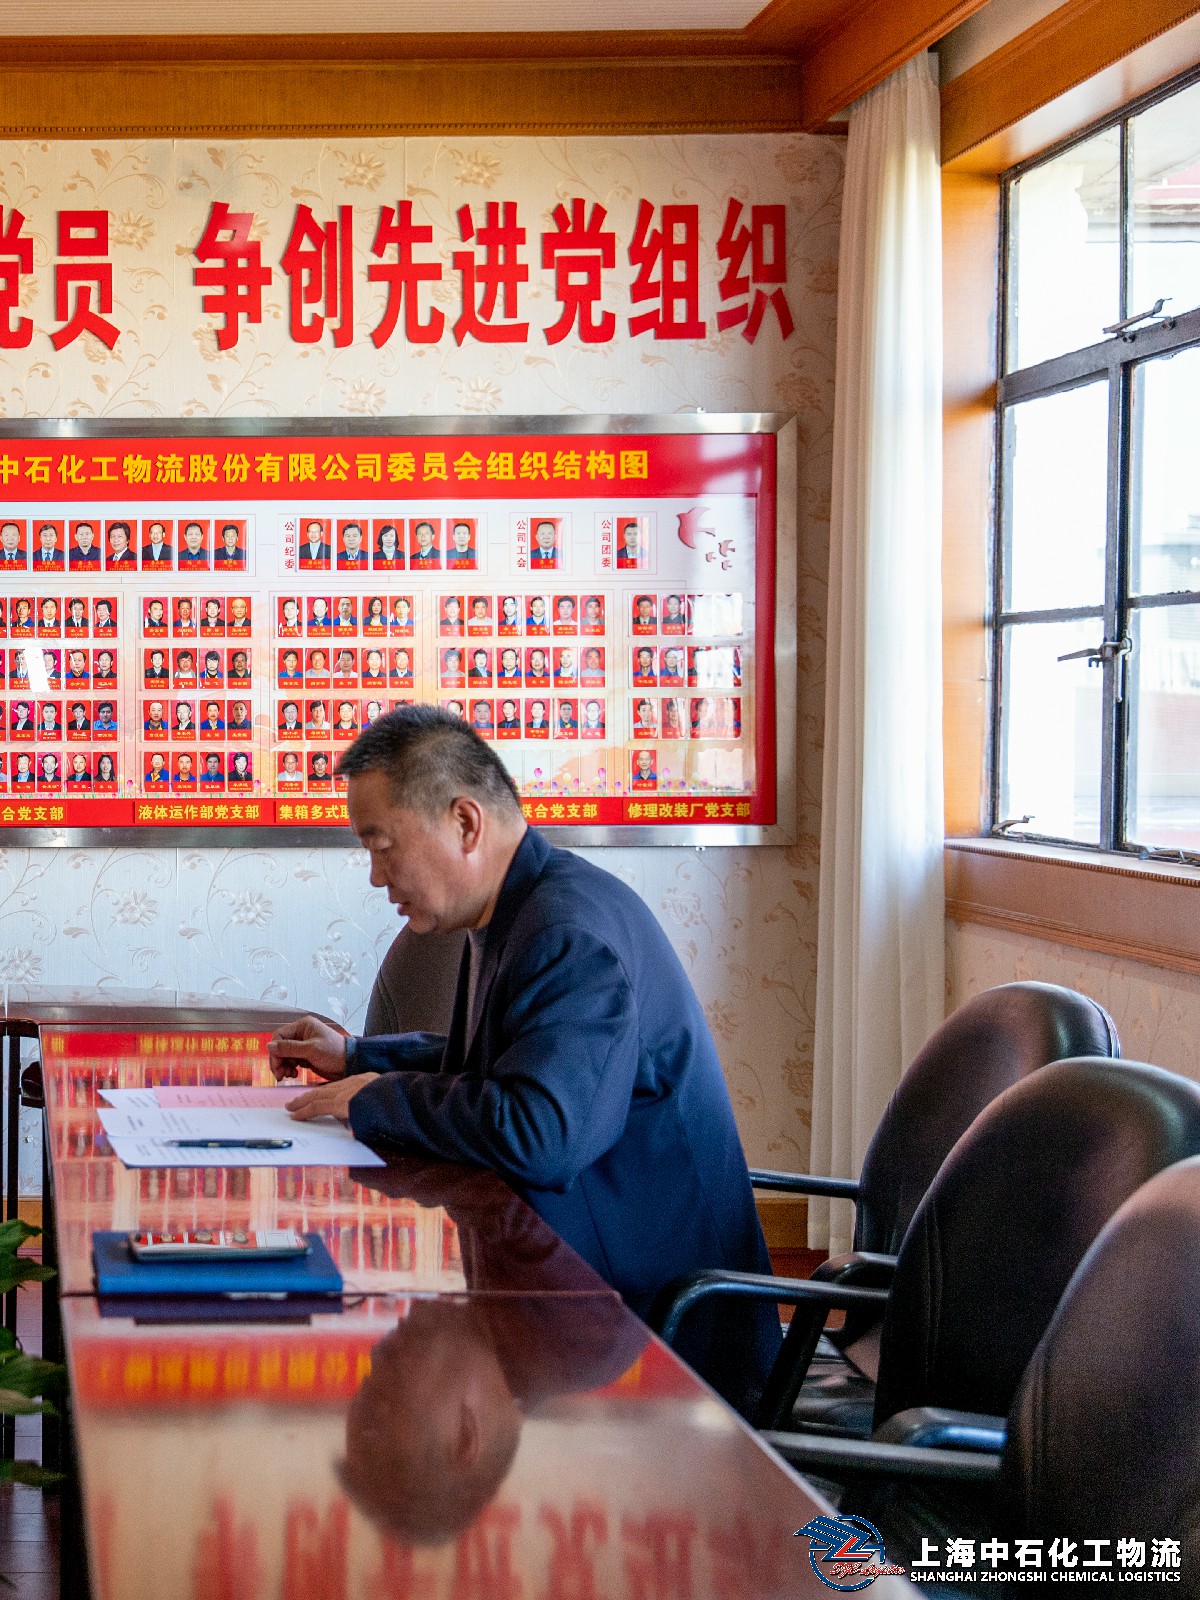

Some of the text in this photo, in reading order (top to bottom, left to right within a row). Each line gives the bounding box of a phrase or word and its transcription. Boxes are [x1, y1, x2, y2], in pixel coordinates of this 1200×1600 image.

[194, 199, 795, 351] 争创先进党组织
[284, 521, 295, 570] 公司纪委
[517, 520, 527, 568] 公司工会
[601, 521, 612, 568] 公司团委
[139, 805, 259, 819] 液体运作部党支部
[628, 803, 751, 818] 修理改装厂党支部
